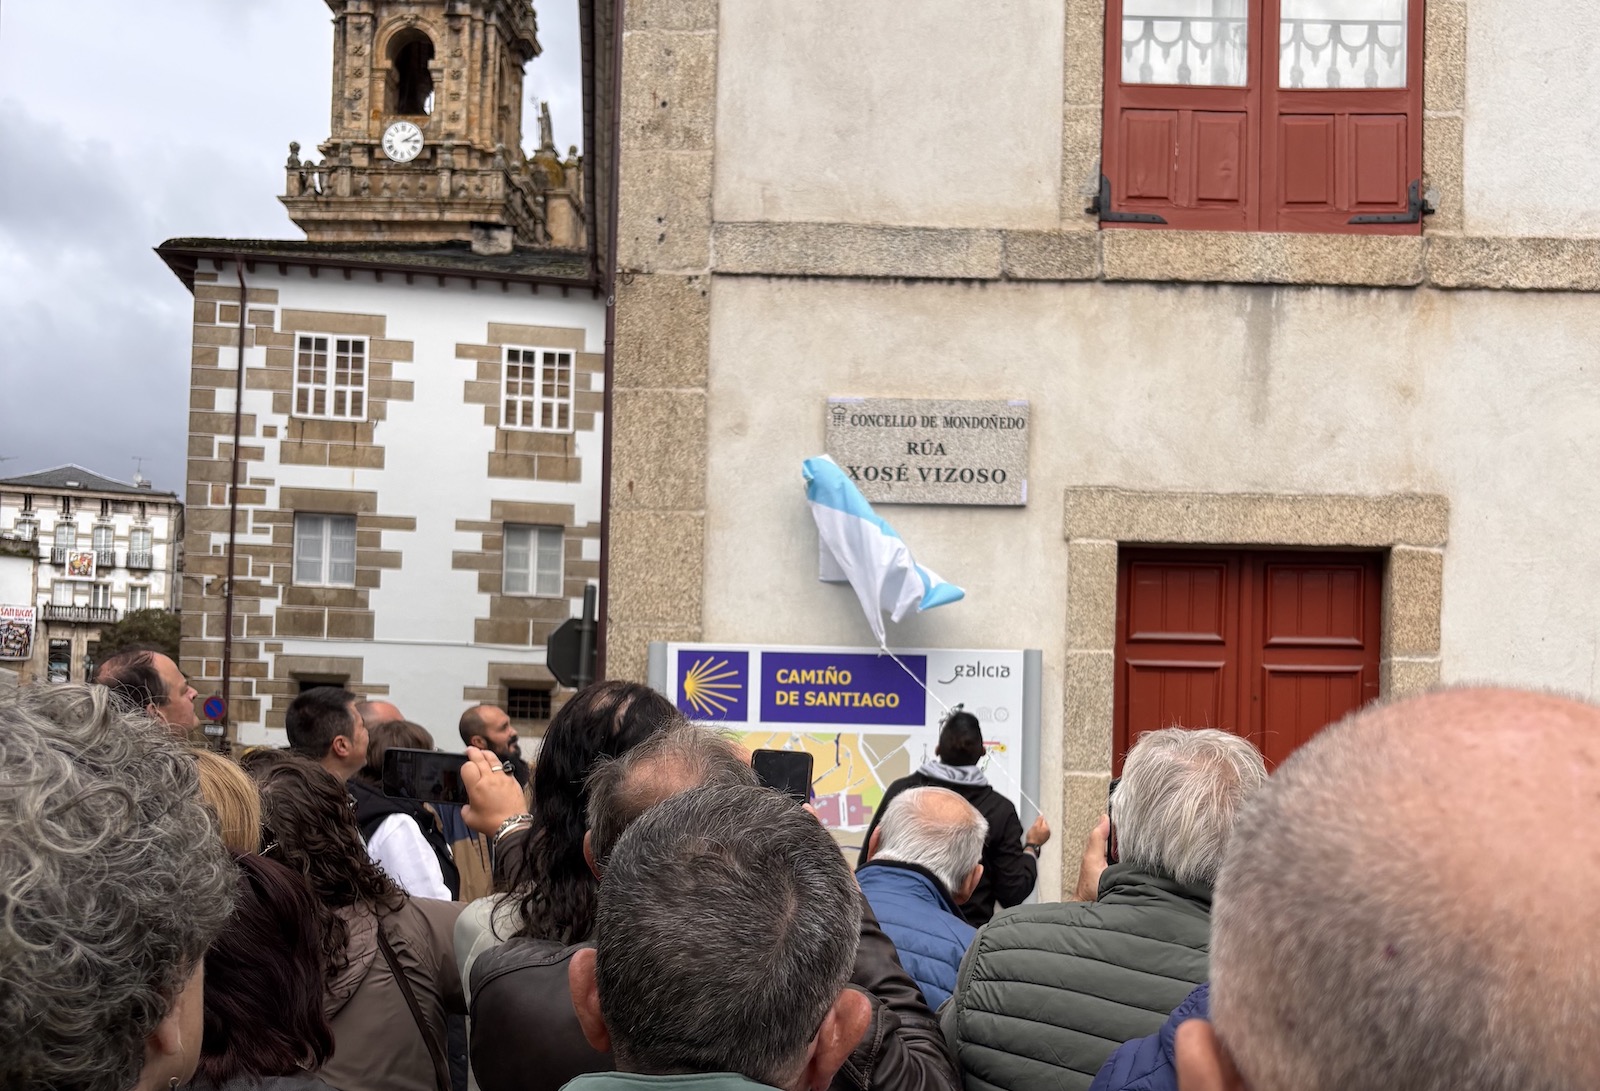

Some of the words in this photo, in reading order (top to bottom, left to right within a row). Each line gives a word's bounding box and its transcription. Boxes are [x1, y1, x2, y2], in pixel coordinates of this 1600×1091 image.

[850, 413, 917, 428] CONCELLO
[921, 415, 938, 429] DE
[943, 414, 1025, 430] MONDOÑEDO
[906, 439, 947, 456] RÚA
[847, 463, 909, 482] XOSÉ
[917, 467, 1007, 484] VIZOSO
[775, 666, 852, 685] CAMIÑO
[938, 661, 1010, 684] galicia
[775, 690, 800, 706] DE
[804, 691, 899, 708] SANTIAGO
